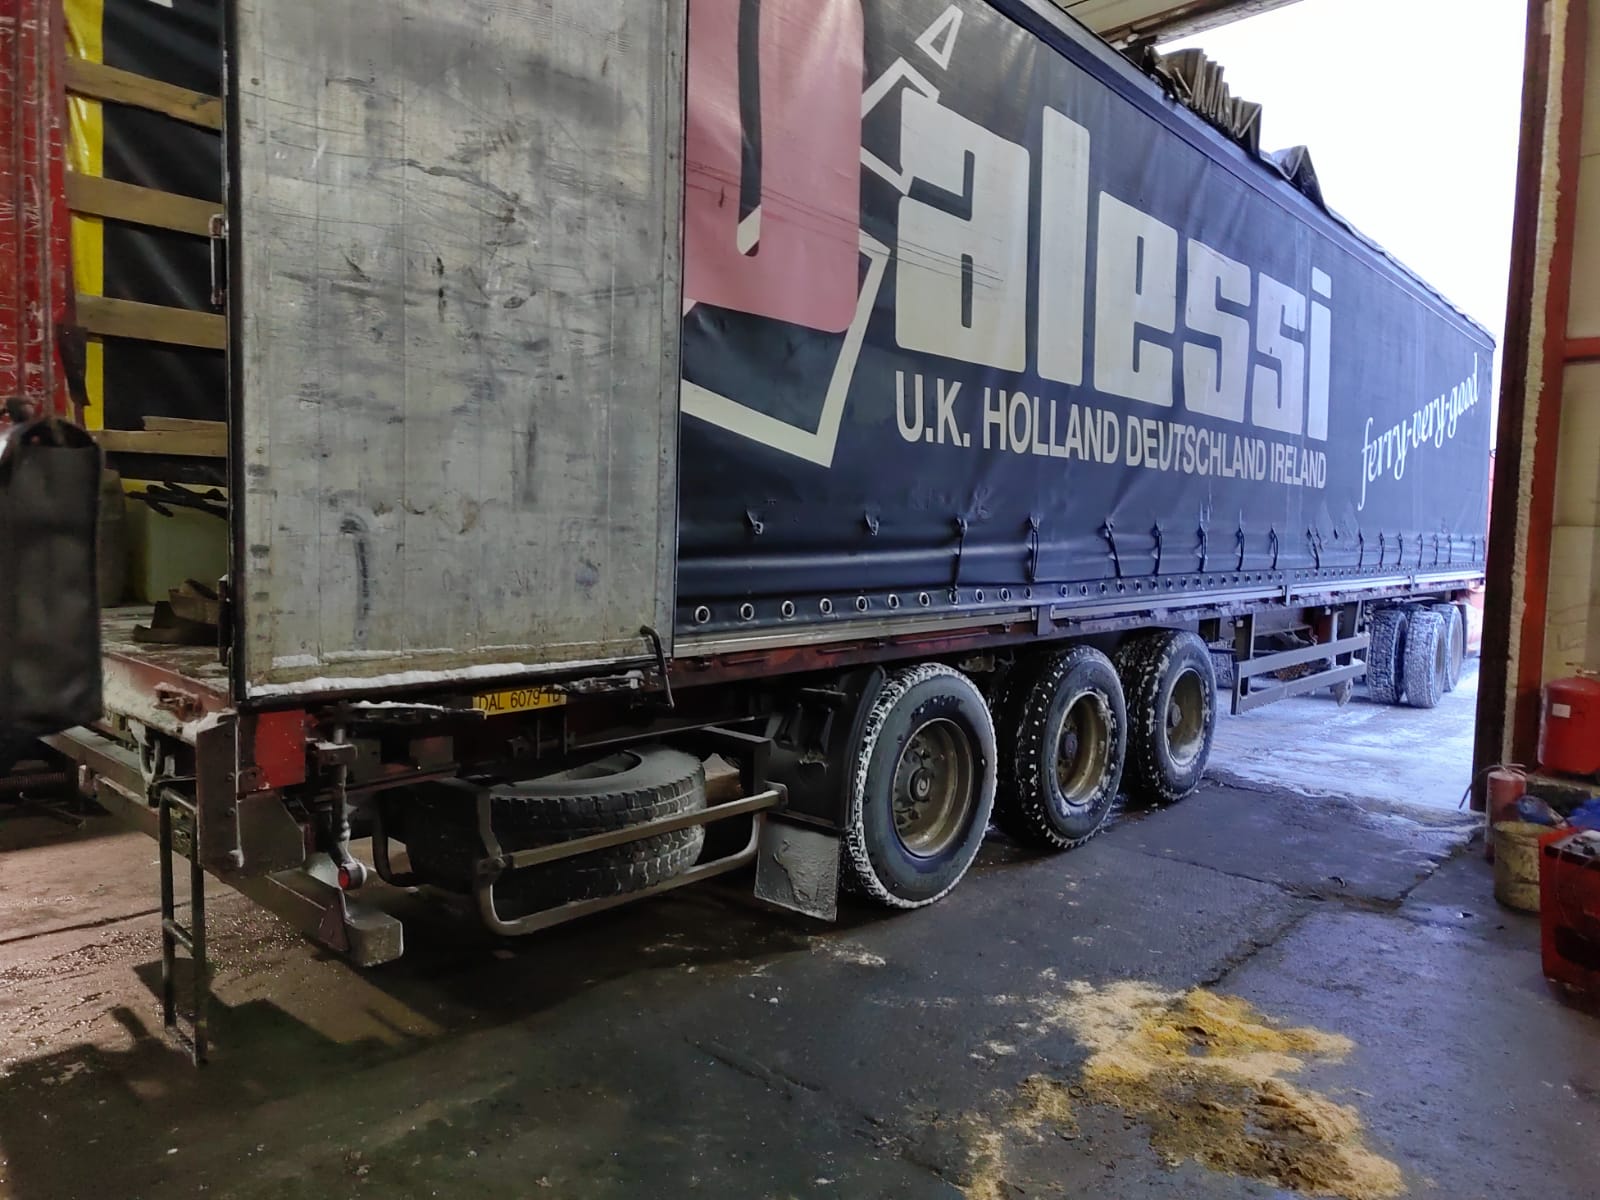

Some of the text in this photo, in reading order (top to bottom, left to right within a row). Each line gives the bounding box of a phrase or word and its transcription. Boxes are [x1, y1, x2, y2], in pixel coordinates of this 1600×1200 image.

[895, 370, 1327, 489] U.K. HOLLAND DEUTSCHLAND IRELAND
[1357, 351, 1479, 511] ferry-very-good
[479, 693, 505, 711] DAL
[510, 689, 540, 708] 6079
